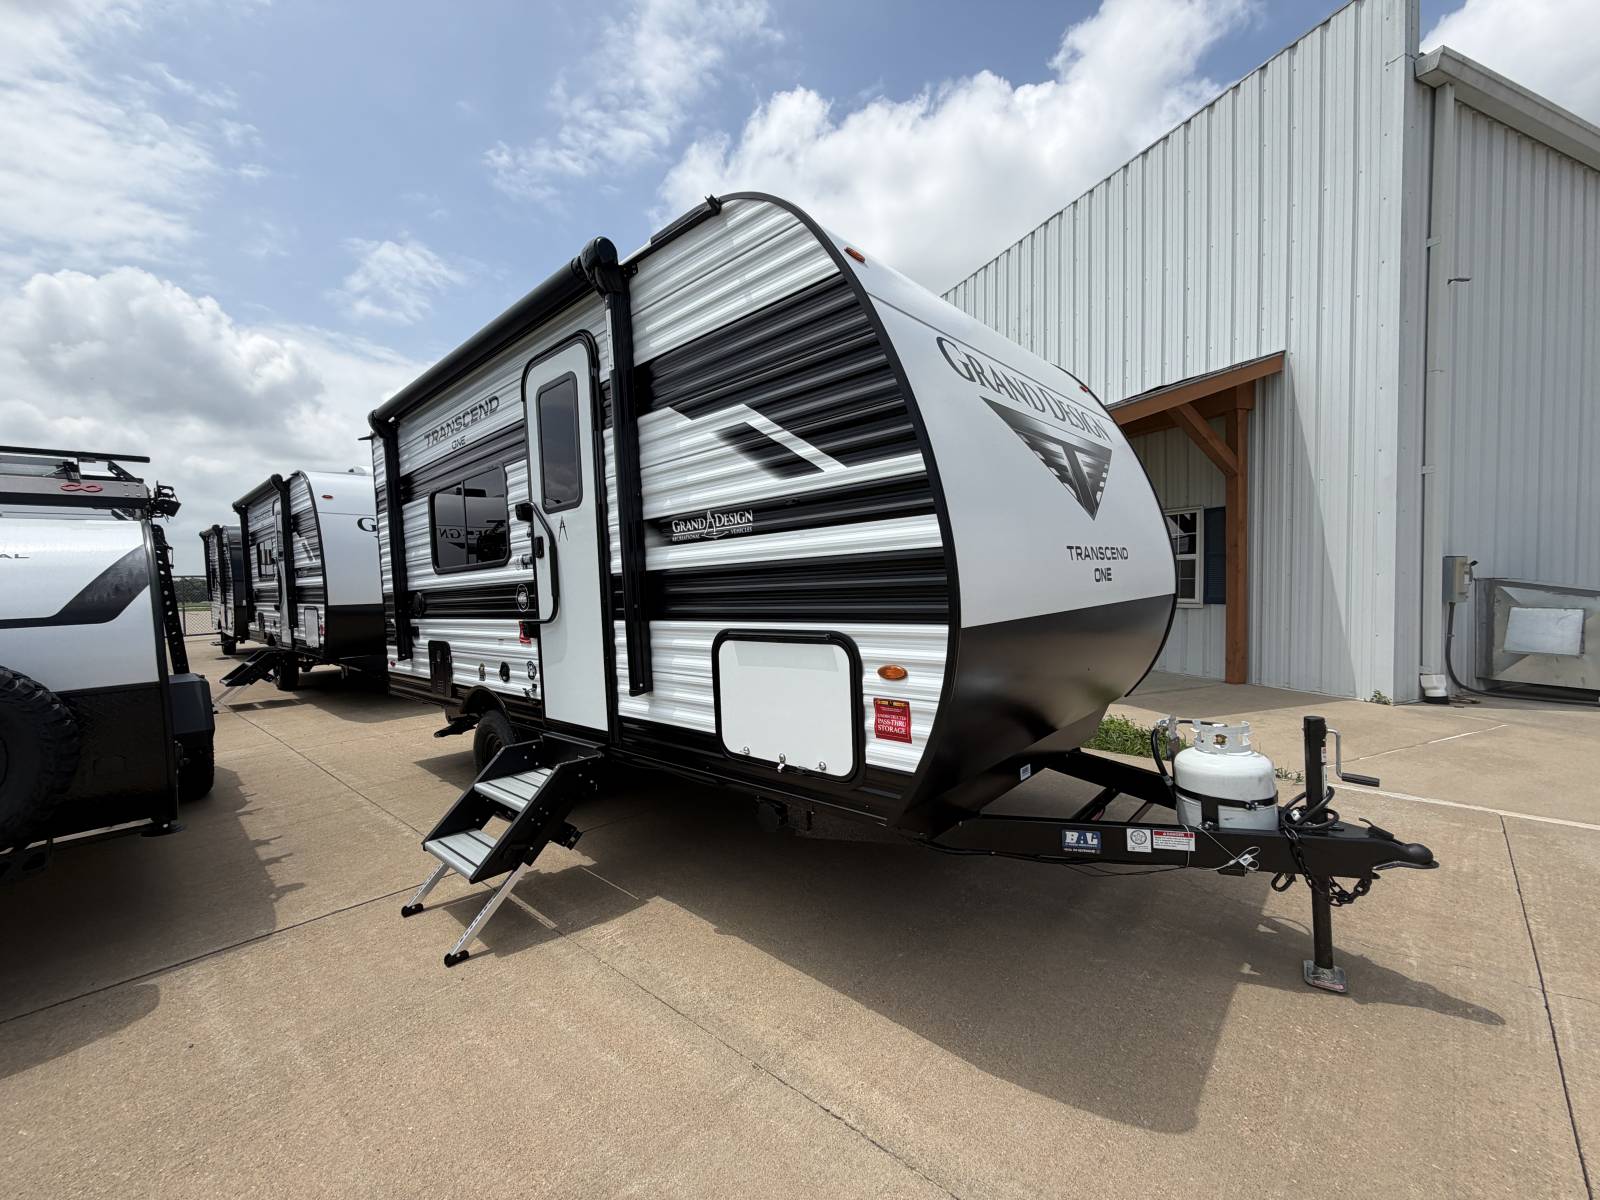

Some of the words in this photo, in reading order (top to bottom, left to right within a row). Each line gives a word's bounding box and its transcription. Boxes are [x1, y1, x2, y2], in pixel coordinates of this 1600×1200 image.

[936, 336, 1046, 413] GRAND
[1035, 386, 1113, 443] DESIGN
[424, 395, 499, 449] TRANSCEND
[452, 435, 466, 449] ONE
[672, 517, 706, 533] GRAND
[714, 509, 753, 527] DESIGN
[1066, 545, 1129, 561] TRANSCEND
[1094, 567, 1112, 582] ONE
[877, 725, 907, 735] STORAGE
